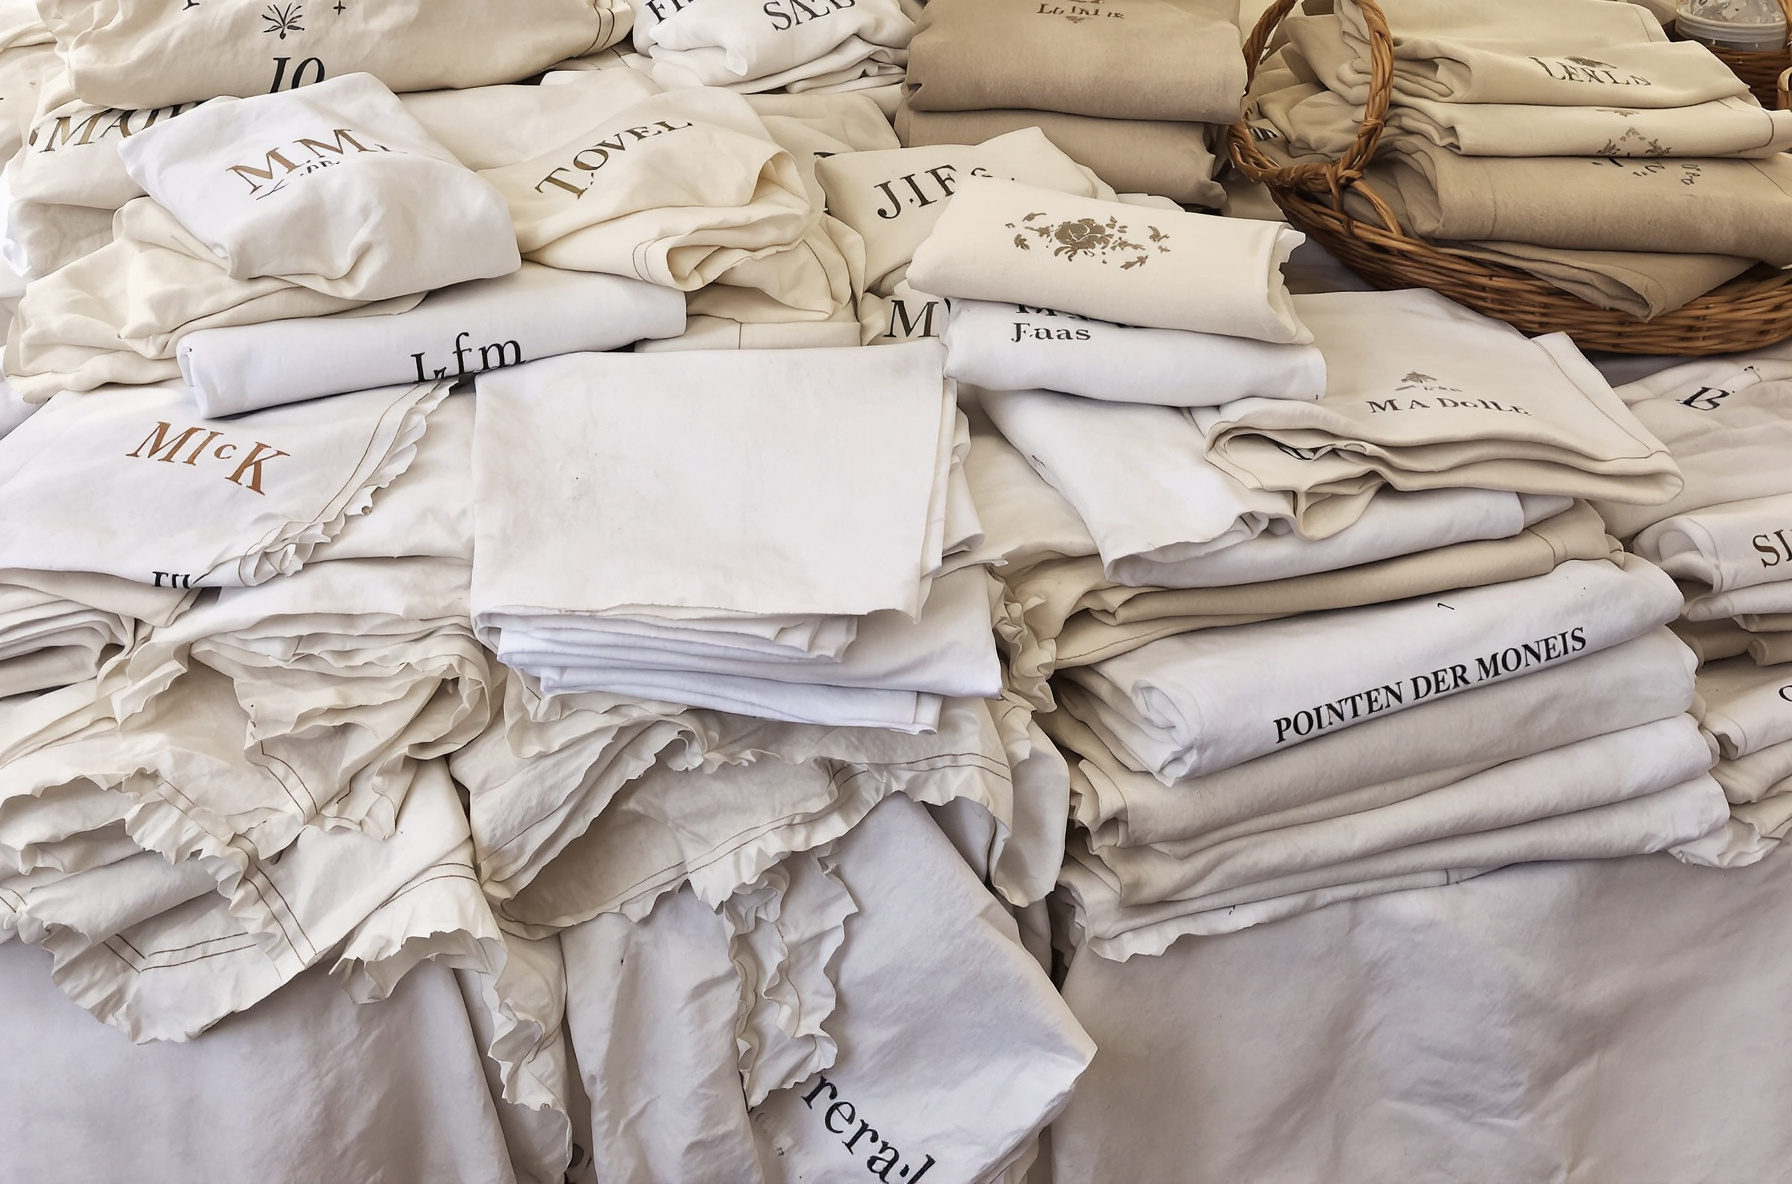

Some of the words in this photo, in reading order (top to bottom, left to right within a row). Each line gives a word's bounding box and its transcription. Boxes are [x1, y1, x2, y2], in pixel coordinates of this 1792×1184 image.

[1272, 681, 1404, 744] POINTEN
[1410, 664, 1471, 701] DER
[1474, 626, 1587, 683] MONEIS
